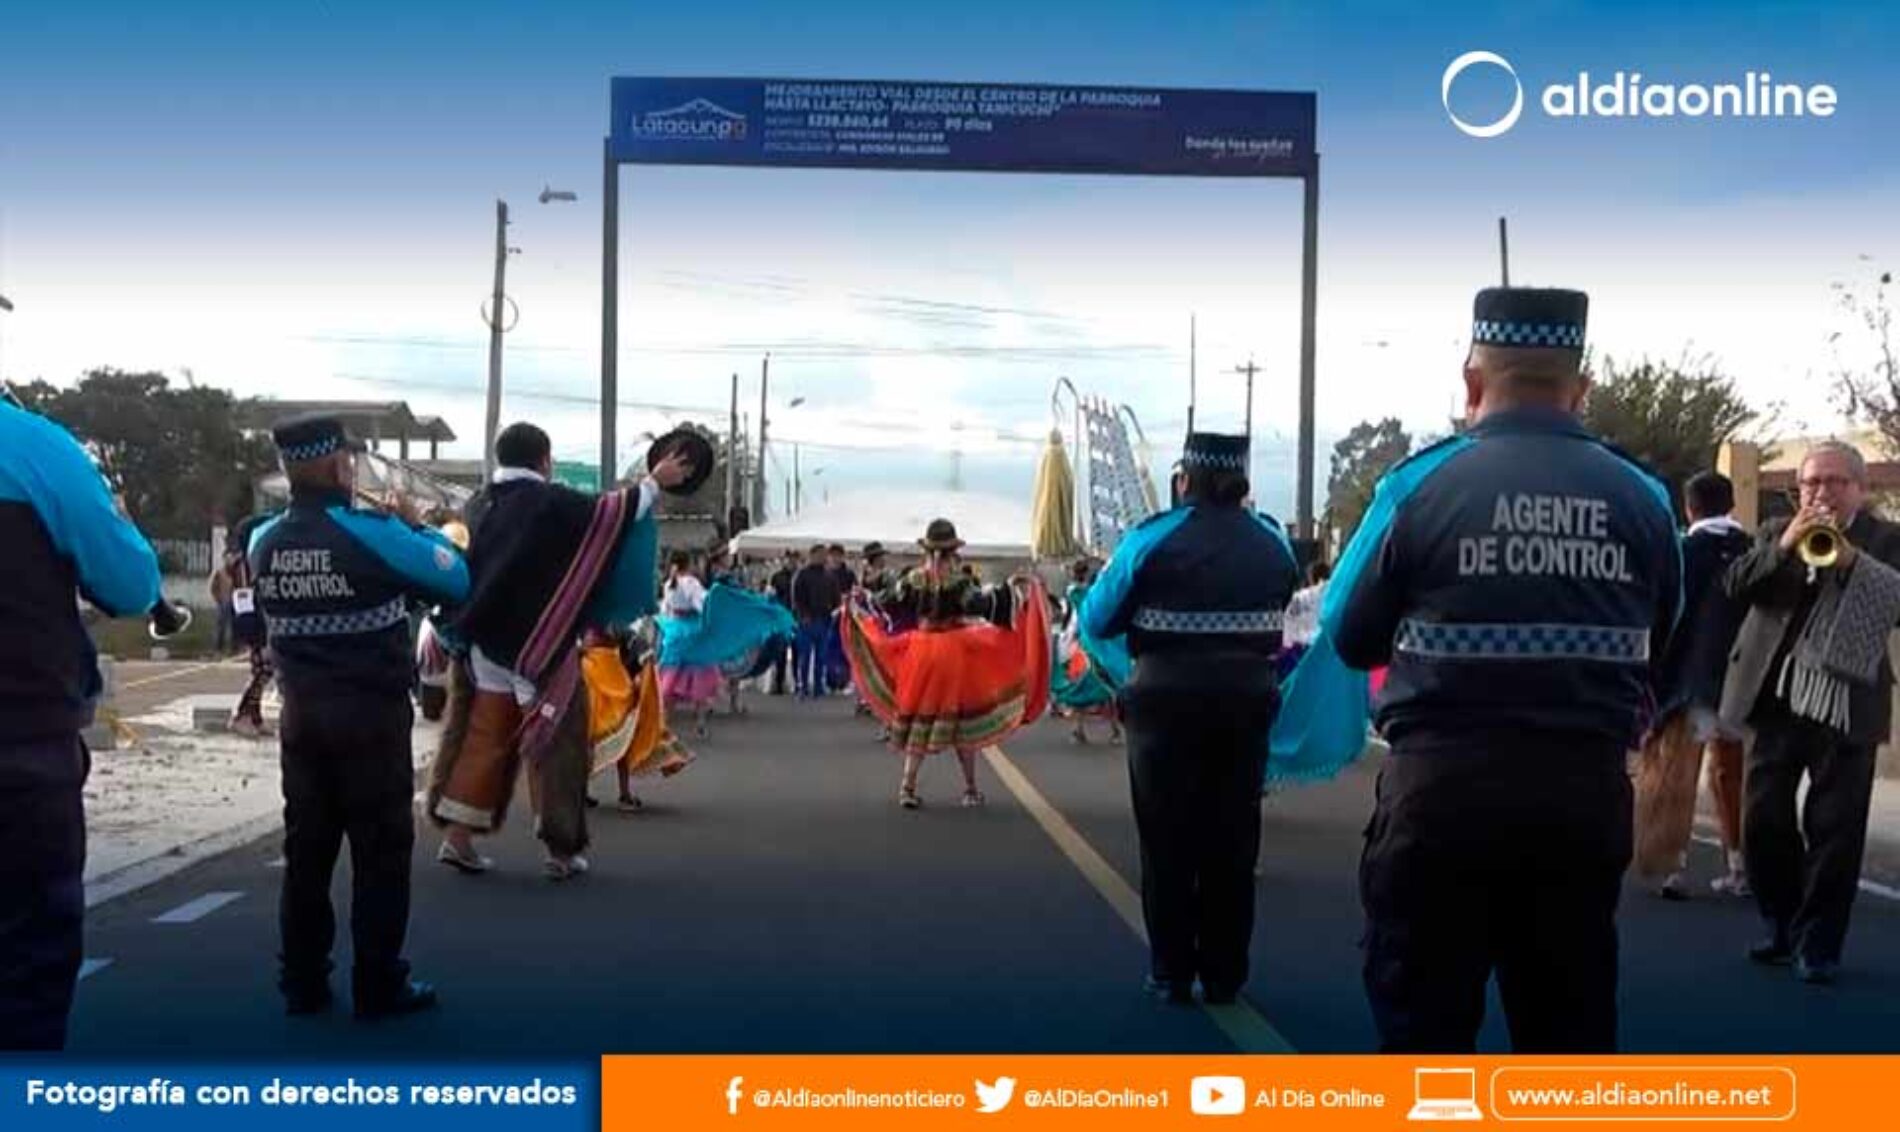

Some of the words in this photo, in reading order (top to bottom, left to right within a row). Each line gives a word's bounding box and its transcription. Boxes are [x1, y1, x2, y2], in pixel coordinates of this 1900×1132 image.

[764, 83, 877, 98] MEJORAMIENTO
[880, 87, 911, 100] VIAL
[914, 87, 959, 101] DESDE
[961, 89, 977, 102] EL
[980, 89, 1036, 103] CENTRO
[1039, 91, 1058, 103] DE
[1060, 92, 1078, 104] LA
[1080, 93, 1161, 106] PARROQUIA
[764, 97, 811, 111] HASTA
[892, 100, 976, 114] PARROQUIA
[1492, 494, 1608, 538] AGENTE
[270, 550, 332, 572] AGENTE
[1458, 536, 1497, 576] DE
[1504, 536, 1633, 582] CONTROL
[280, 574, 355, 598] CONTROL
